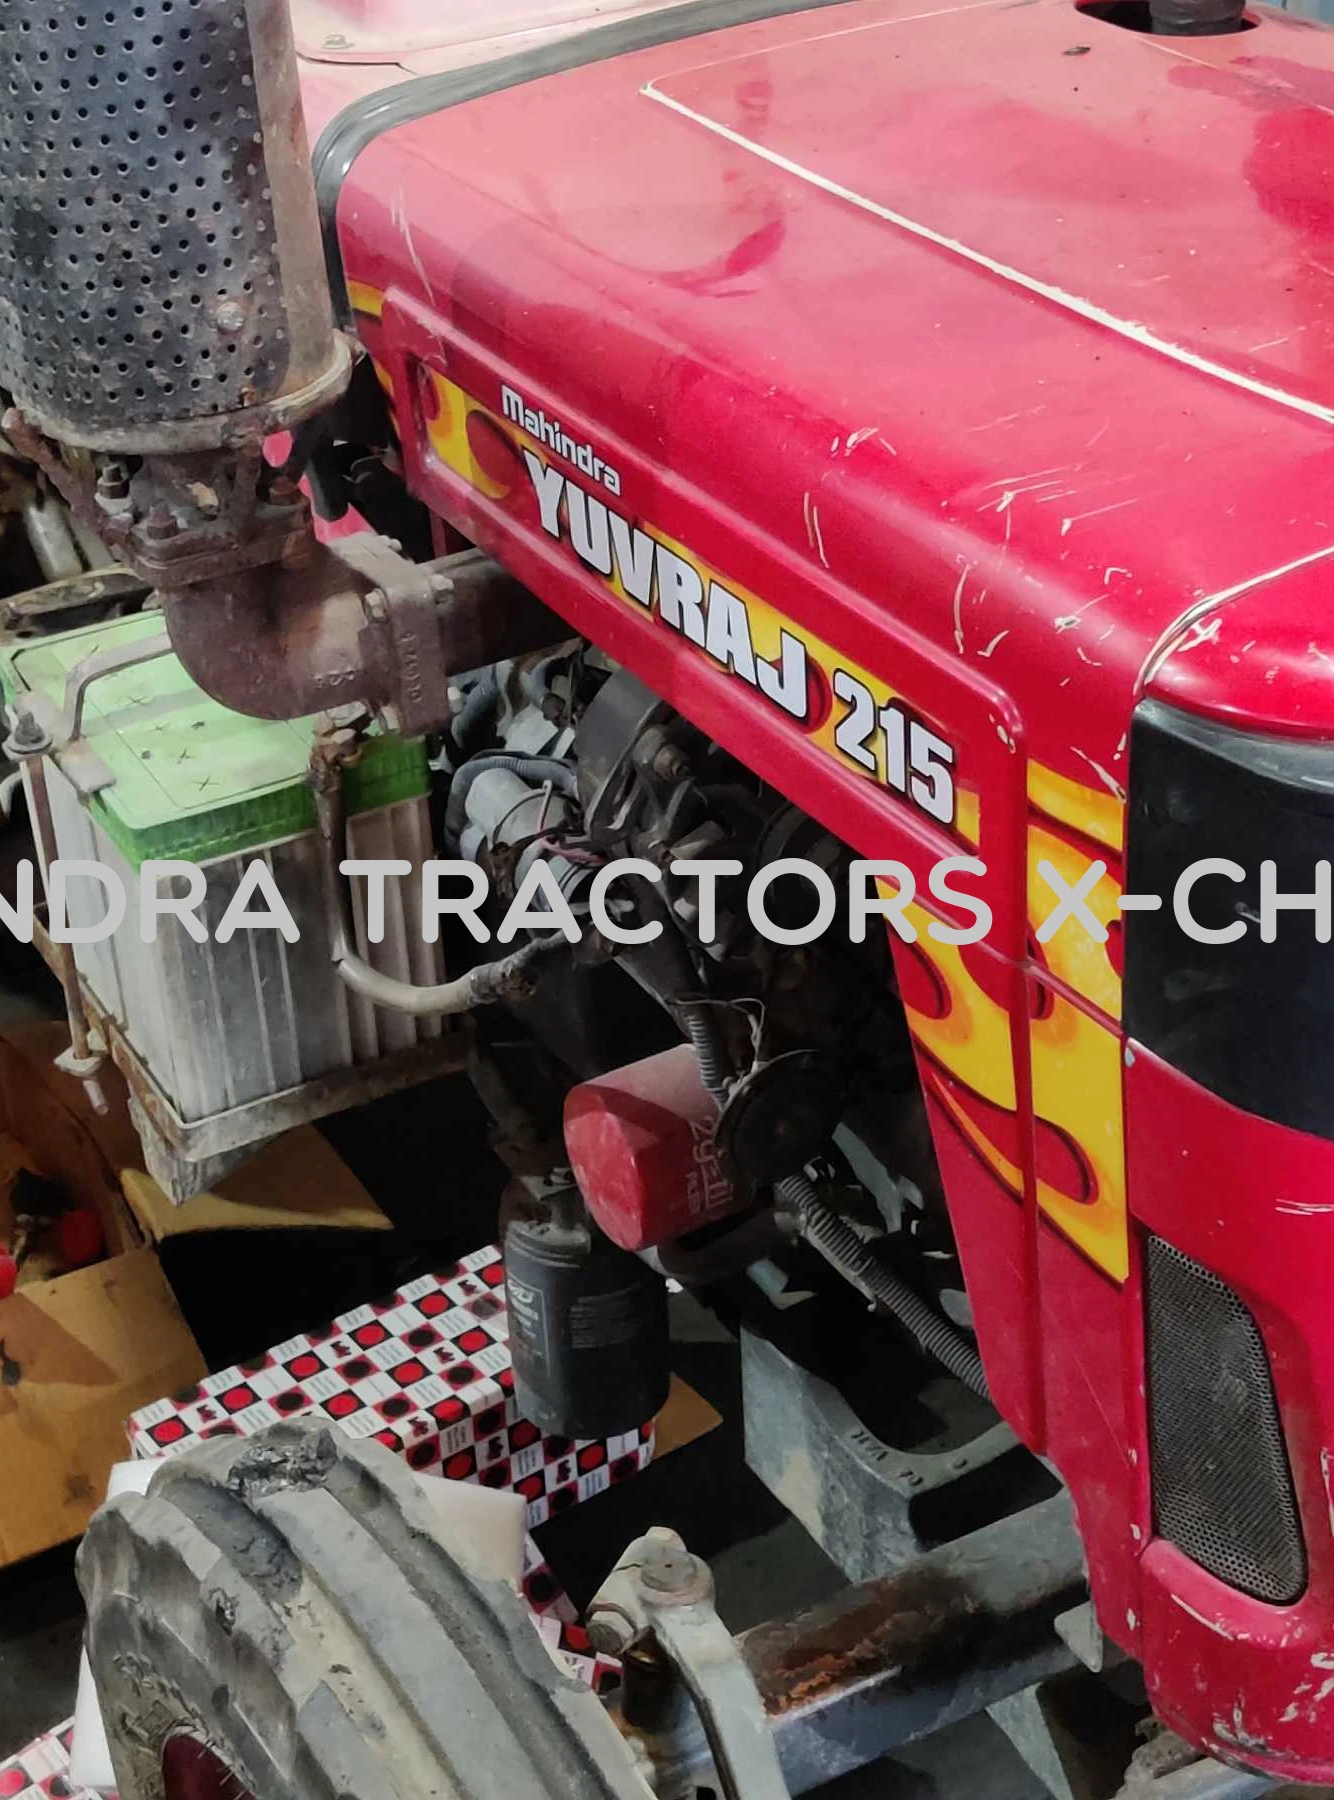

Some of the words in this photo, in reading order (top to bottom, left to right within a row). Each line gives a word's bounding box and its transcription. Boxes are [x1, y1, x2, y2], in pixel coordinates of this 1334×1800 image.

[501, 384, 621, 497] Mahindra
[522, 445, 808, 720] YUVRAJ
[832, 667, 955, 826] 215
